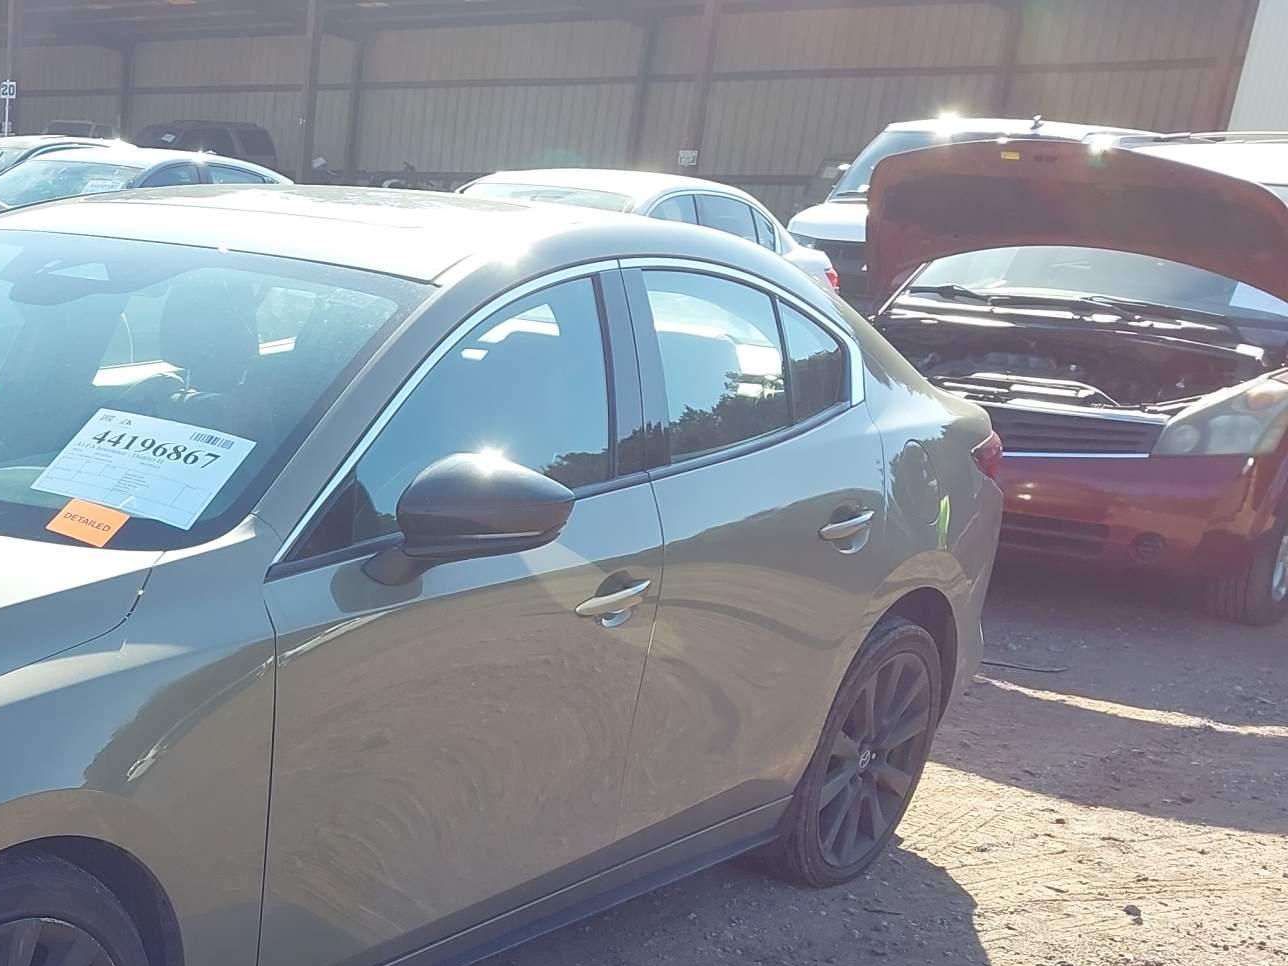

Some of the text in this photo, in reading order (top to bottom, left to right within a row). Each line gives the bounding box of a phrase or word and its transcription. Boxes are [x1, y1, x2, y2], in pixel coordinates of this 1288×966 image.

[1, 84, 15, 96] 20
[92, 430, 221, 469] 44196867
[63, 511, 112, 533] DETAILED
